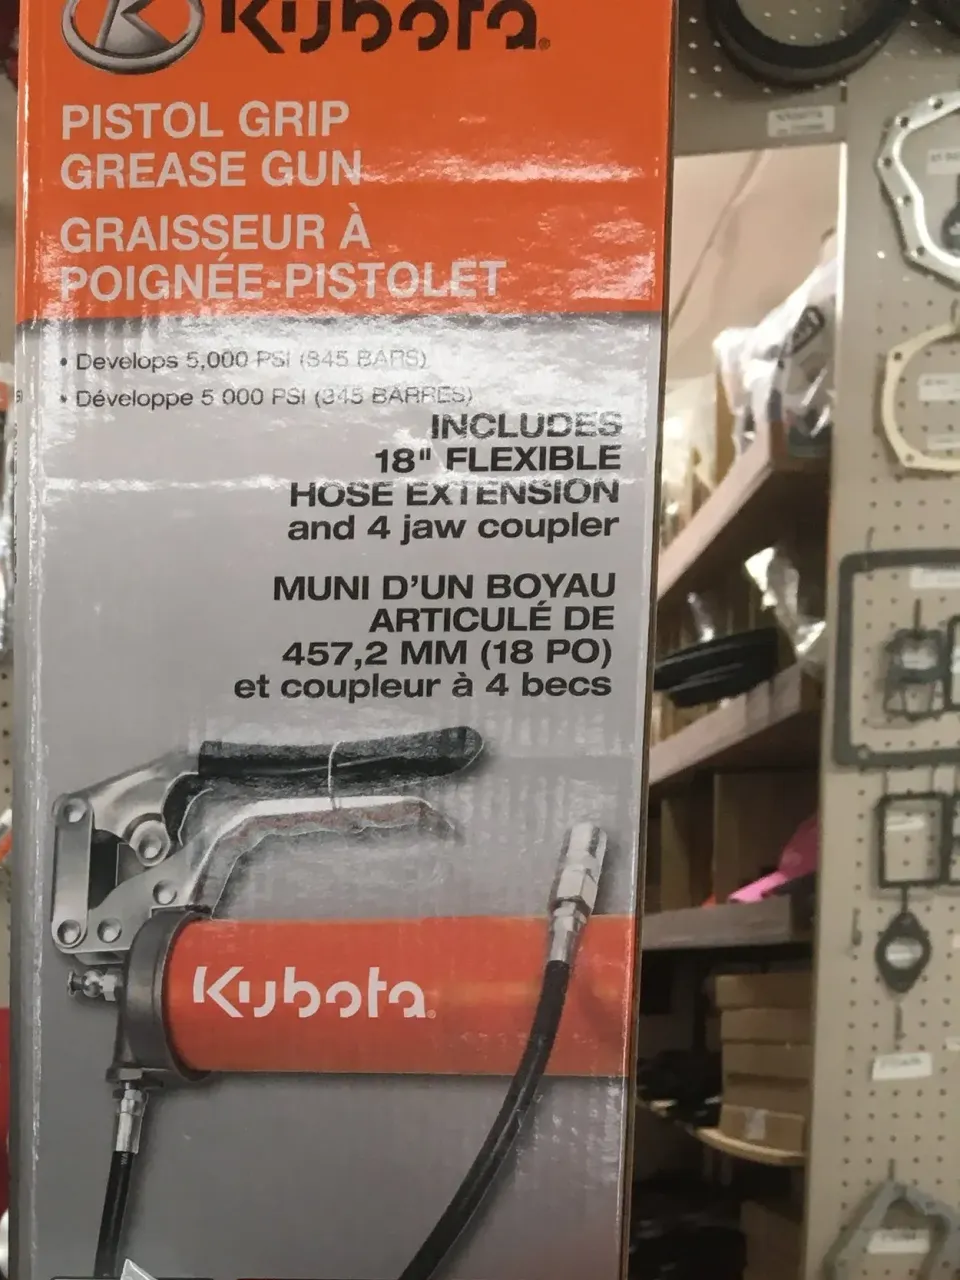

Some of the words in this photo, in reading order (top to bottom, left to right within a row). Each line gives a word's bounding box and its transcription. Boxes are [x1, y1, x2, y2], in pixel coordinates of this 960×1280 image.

[62, 102, 224, 141] PISTOL
[239, 100, 350, 138] GRIP
[60, 150, 246, 191] GREASE
[261, 150, 362, 188] GUN
[60, 214, 325, 254] GRAISSEUR
[339, 202, 371, 249] À
[60, 251, 507, 301] POIGNÉE-PISTOLET
[76, 351, 179, 373] Develops
[186, 350, 248, 372] 5,000
[257, 350, 291, 370] PSI
[75, 387, 194, 410] Développe
[271, 387, 306, 406] PSI
[431, 411, 623, 440] INCLUDES
[375, 447, 432, 474] 18"
[446, 444, 622, 473] FLEXIBLE
[290, 482, 394, 508] HOSE
[406, 478, 620, 506] EXTENSION
[288, 514, 355, 541] and
[367, 514, 391, 540] 4
[401, 513, 466, 545] jaw
[478, 513, 620, 543] coupler
[273, 575, 369, 602] MUNI
[487, 572, 617, 599] BOYAU
[369, 600, 552, 633] ARTICULÉ
[564, 605, 615, 631] DE
[282, 640, 388, 671] 457,2
[400, 640, 467, 666] MM
[481, 638, 534, 670] (18
[547, 637, 613, 670] PO)
[234, 675, 271, 699] et
[280, 673, 441, 702] coupleur
[453, 670, 475, 697] à
[486, 672, 510, 697] 4
[521, 671, 612, 697] becs
[193, 966, 428, 1018] Kubota
